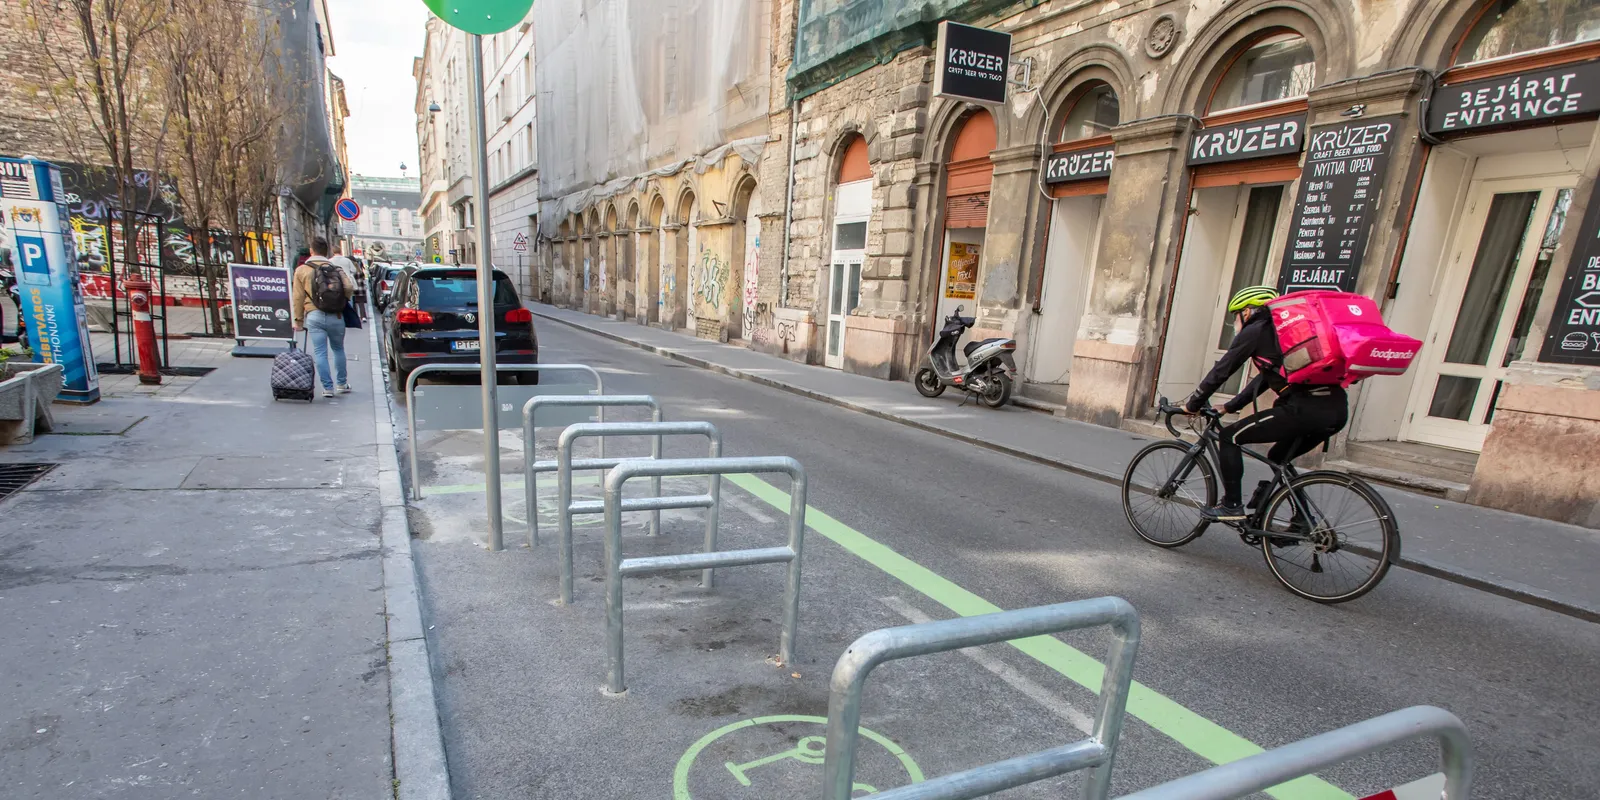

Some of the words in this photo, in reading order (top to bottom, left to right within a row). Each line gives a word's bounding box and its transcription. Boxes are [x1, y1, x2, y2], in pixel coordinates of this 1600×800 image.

[949, 48, 1003, 72] KRÜZER
[1460, 73, 1576, 108] BEJÁRAT
[1442, 93, 1582, 129] ENTRANCE
[1191, 120, 1299, 159] KRÜZER
[1310, 123, 1392, 152] KRÜZER
[1313, 150, 1333, 159] CRAFT
[1334, 148, 1351, 157] BEER
[1352, 146, 1365, 155] AND
[1366, 144, 1382, 153] FOOD
[1313, 160, 1346, 177] NYITVA
[1349, 157, 1374, 173] OPEN
[23, 243, 42, 266] P
[250, 276, 286, 284] LUGGAGE
[1292, 266, 1345, 284] BEJÁRAT
[252, 284, 286, 292] STORAGE
[457, 340, 480, 349] PTF-
[1369, 347, 1413, 361] foodpanda
